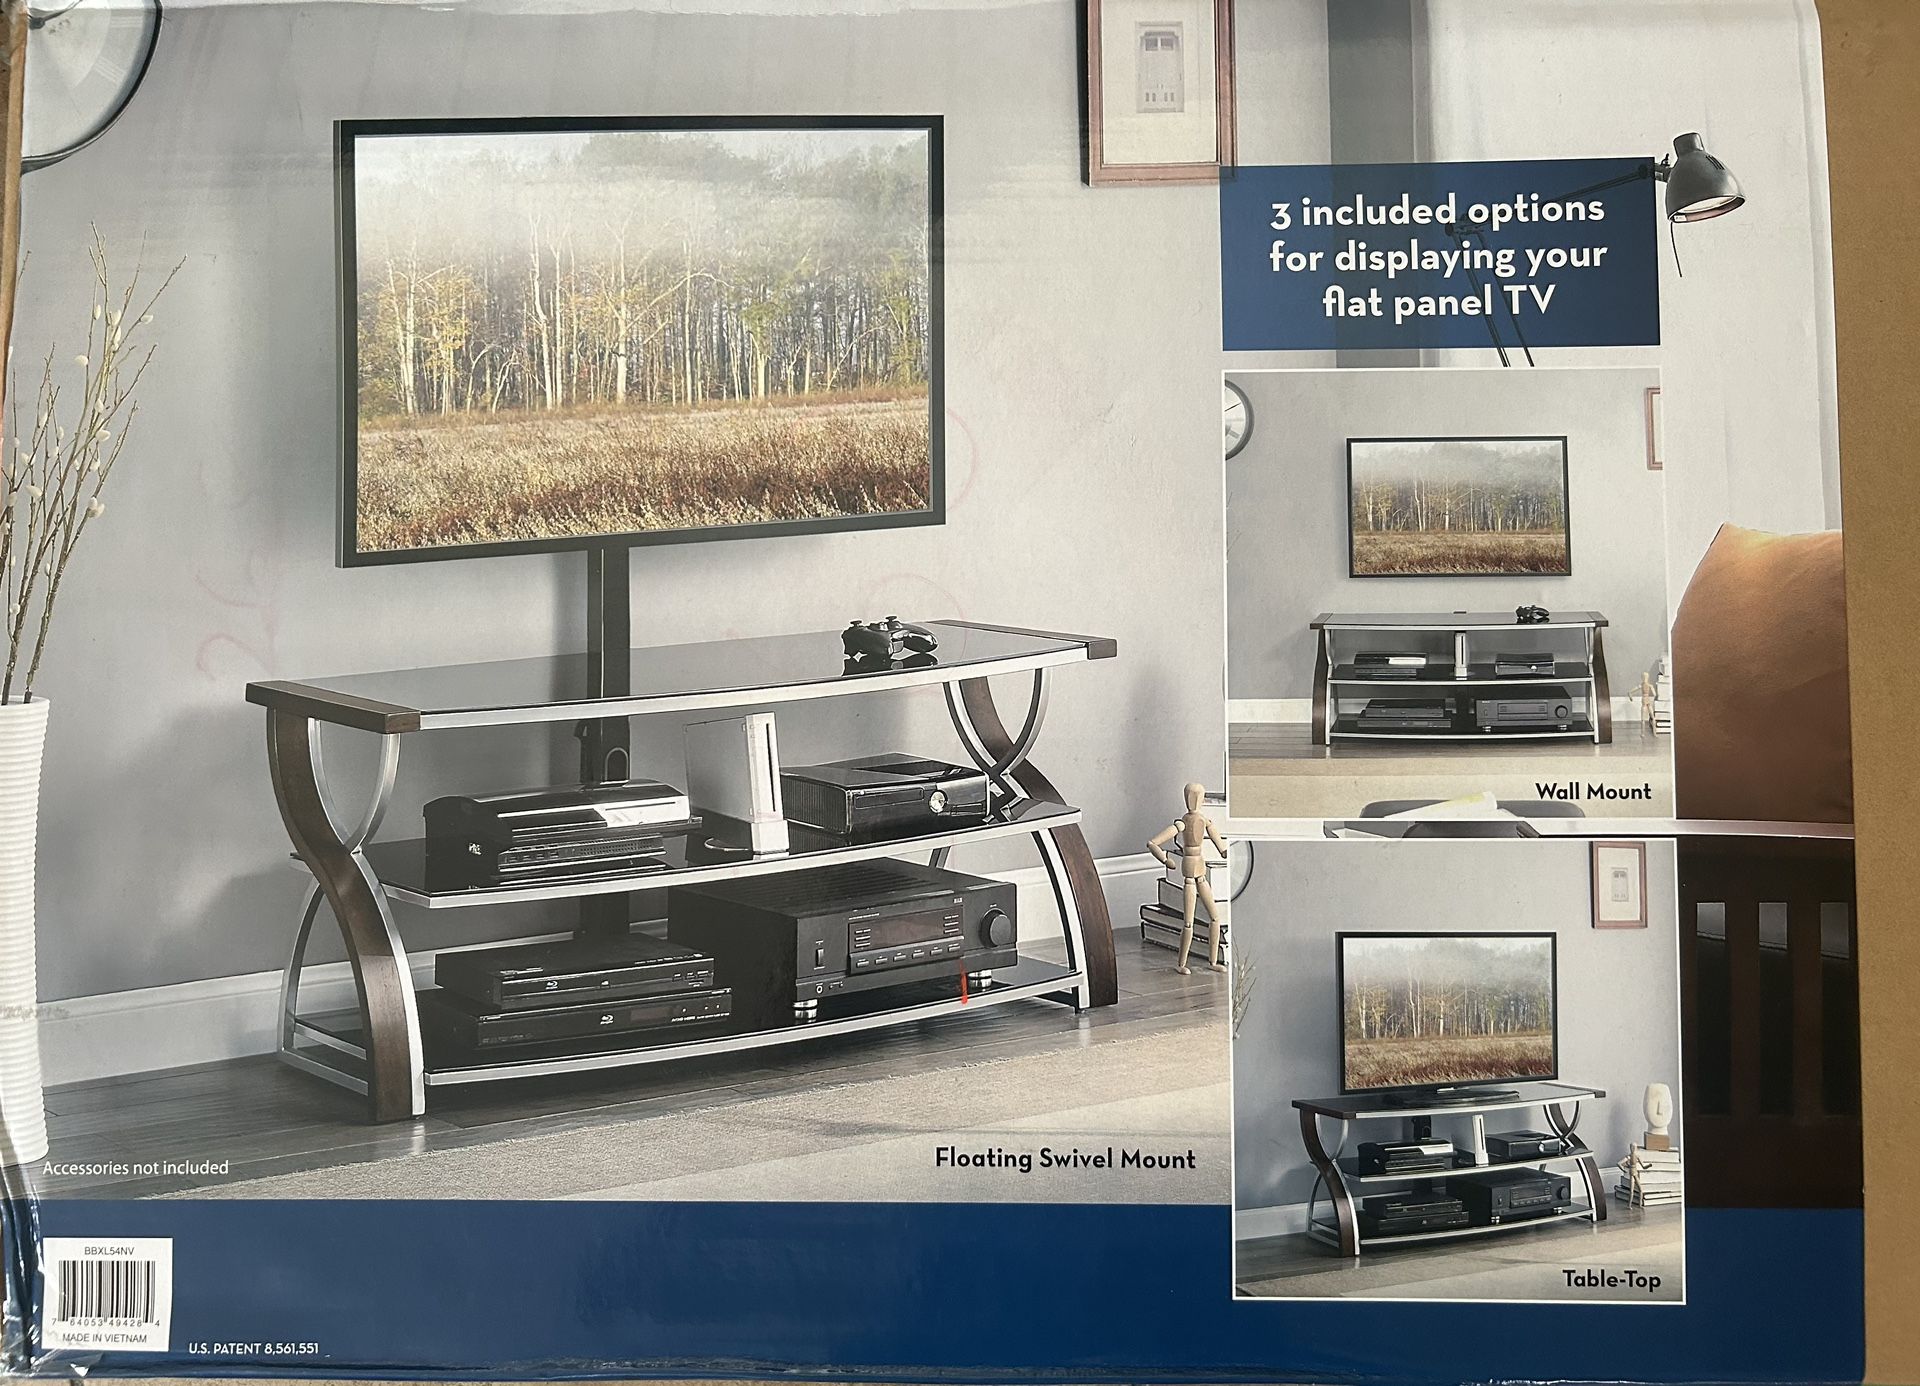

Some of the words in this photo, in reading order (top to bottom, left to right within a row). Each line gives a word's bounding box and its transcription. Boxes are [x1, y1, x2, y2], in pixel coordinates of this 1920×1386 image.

[1270, 202, 1291, 231] 3
[1302, 192, 1456, 226] included
[1468, 192, 1605, 231] options
[1269, 240, 1323, 272] for
[1335, 238, 1515, 279] displaying
[1525, 247, 1608, 277] your
[1323, 284, 1383, 317] flat
[1395, 283, 1492, 325] panel
[1503, 284, 1556, 315] TV
[1535, 781, 1580, 800] Wall
[1587, 782, 1651, 800] Mount
[43, 1161, 129, 1175] Accessories
[134, 1162, 159, 1175] not
[163, 1159, 229, 1175] included
[935, 1146, 1032, 1173] Floating
[1039, 1147, 1113, 1168] Swivel
[1121, 1148, 1196, 1169] Mount
[84, 1246, 135, 1256] BBXL54NV
[1562, 1268, 1662, 1293] Table-Top
[62, 1333, 90, 1343] MADE
[92, 1333, 102, 1343] IN
[104, 1333, 148, 1344] VIETNAM
[188, 1342, 211, 1354] U.S.
[213, 1342, 262, 1355] PATENT
[264, 1342, 320, 1356] 8,561,551
